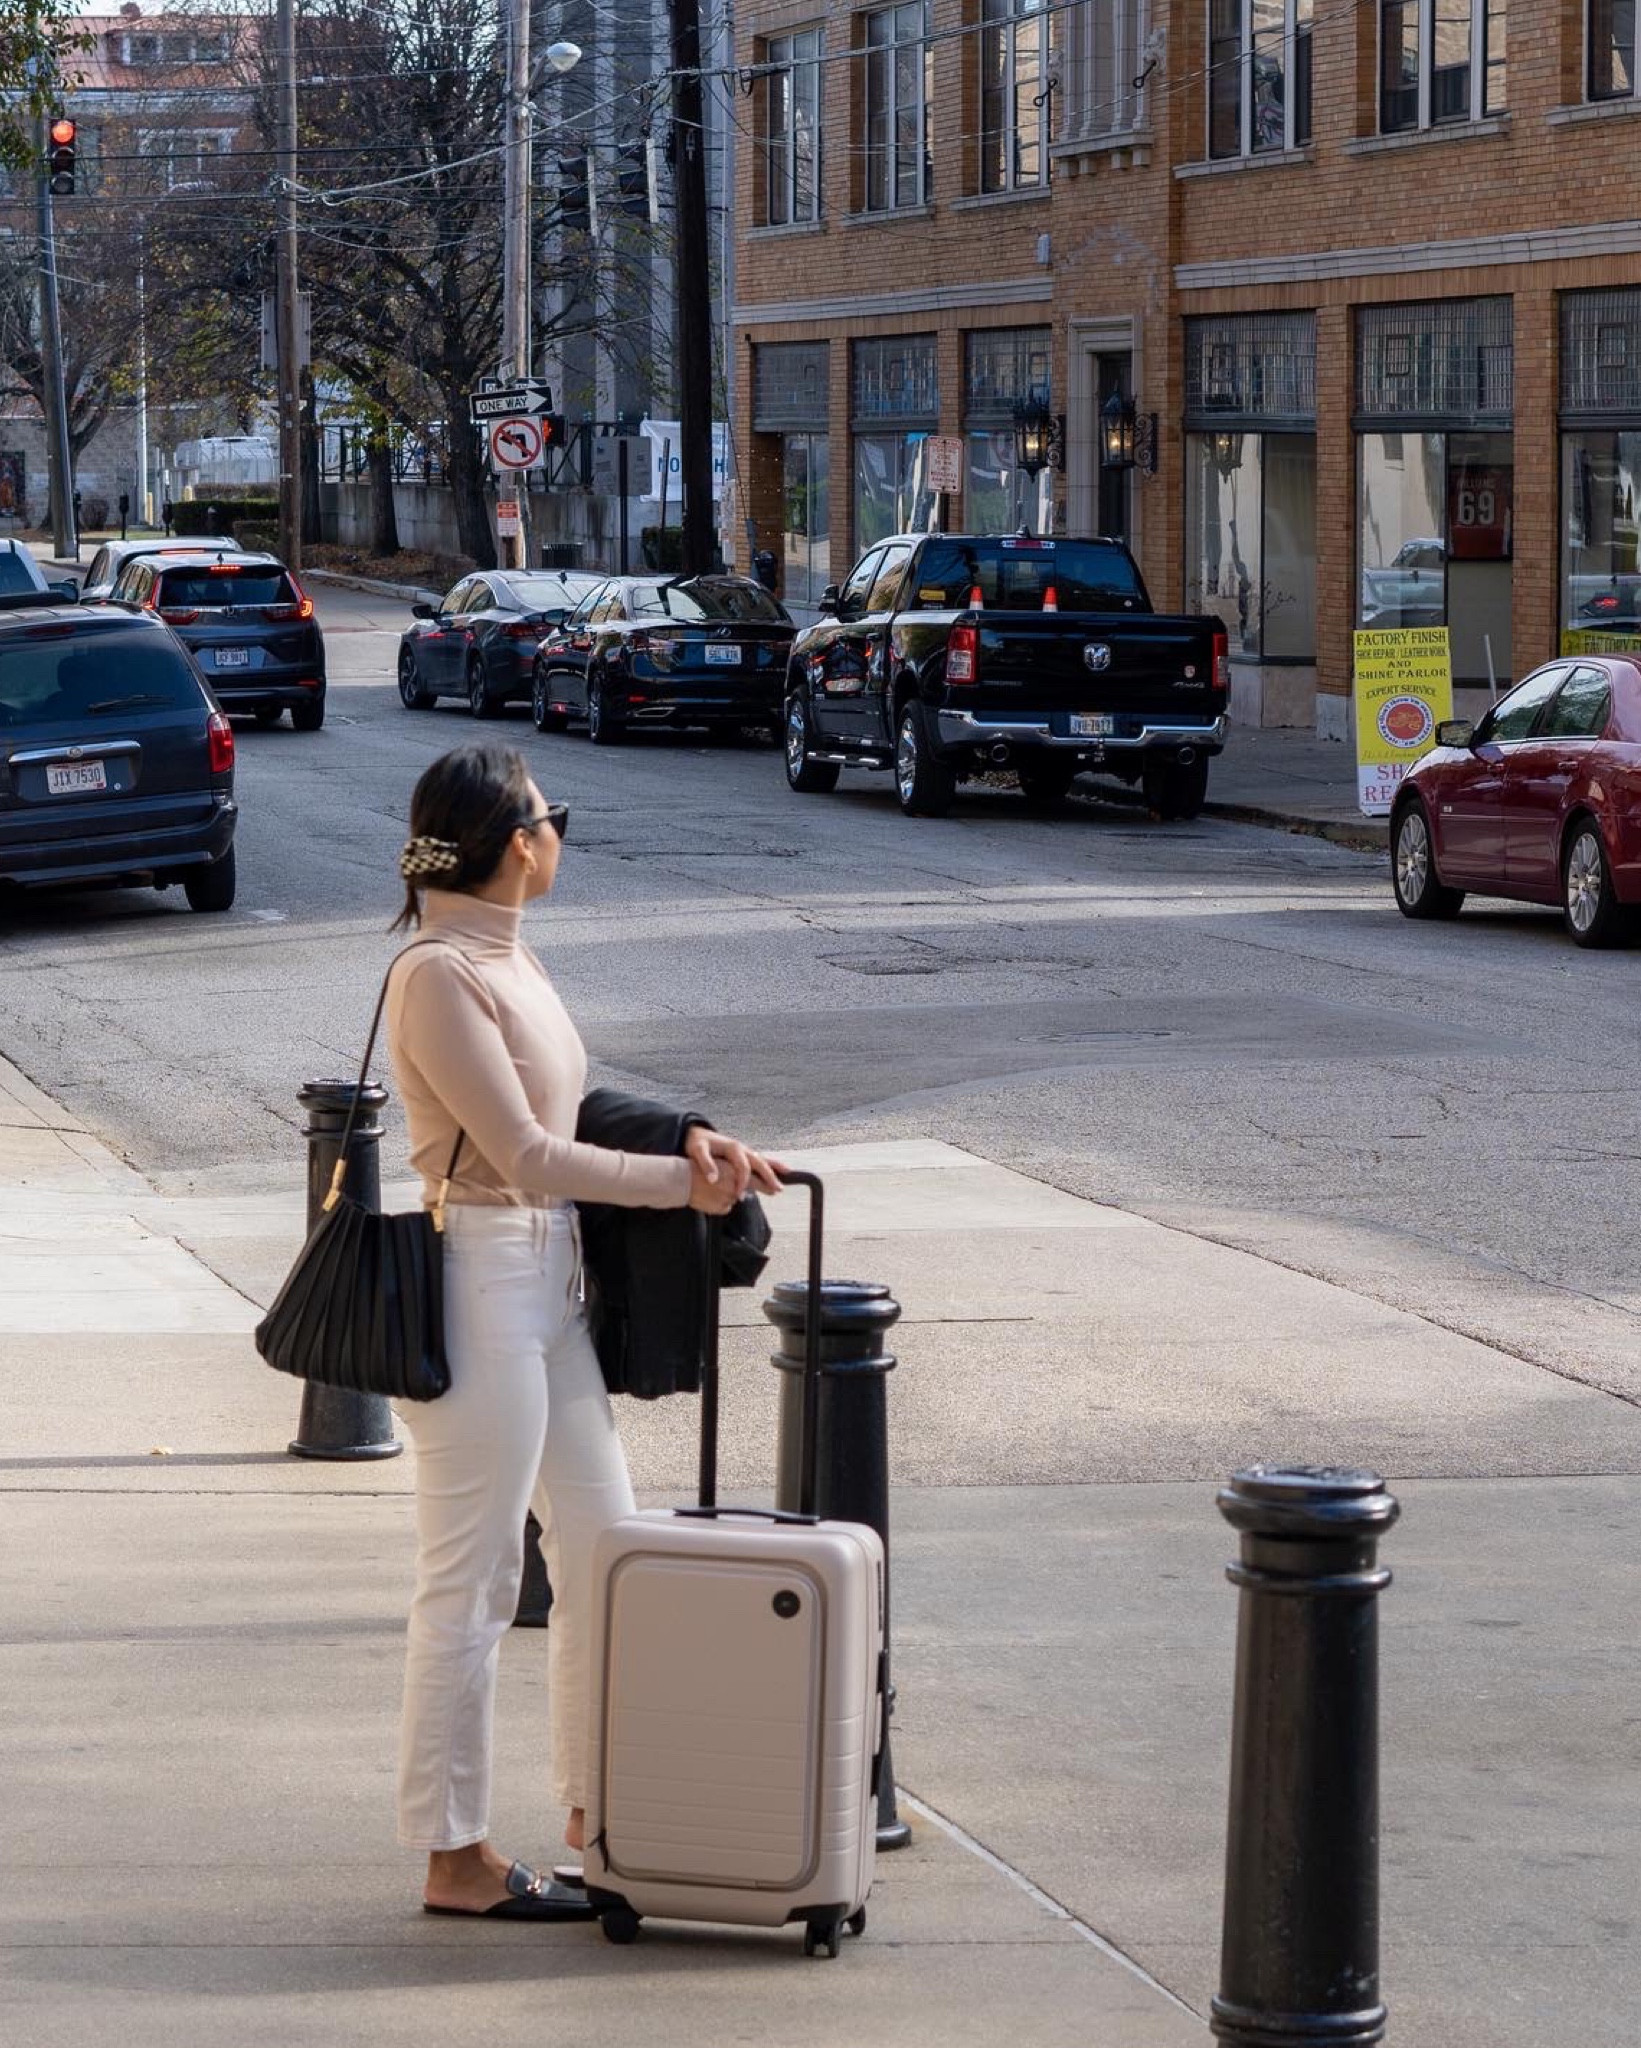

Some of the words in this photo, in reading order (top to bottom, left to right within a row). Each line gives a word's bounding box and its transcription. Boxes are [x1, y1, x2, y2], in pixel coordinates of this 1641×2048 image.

[480, 400, 503, 412] ONE
[505, 397, 527, 408] WAY
[1458, 491, 1494, 524] 69
[1357, 631, 1408, 645] FACTORY
[1411, 630, 1446, 643] FINISH
[1388, 660, 1412, 668] AND
[1358, 670, 1394, 679] SHINE
[1398, 668, 1447, 678] PARLOR
[1366, 685, 1400, 699] EXPERT
[1400, 685, 1436, 697] SERVICE
[53, 771, 72, 787] JIX
[74, 766, 101, 784] 7530
